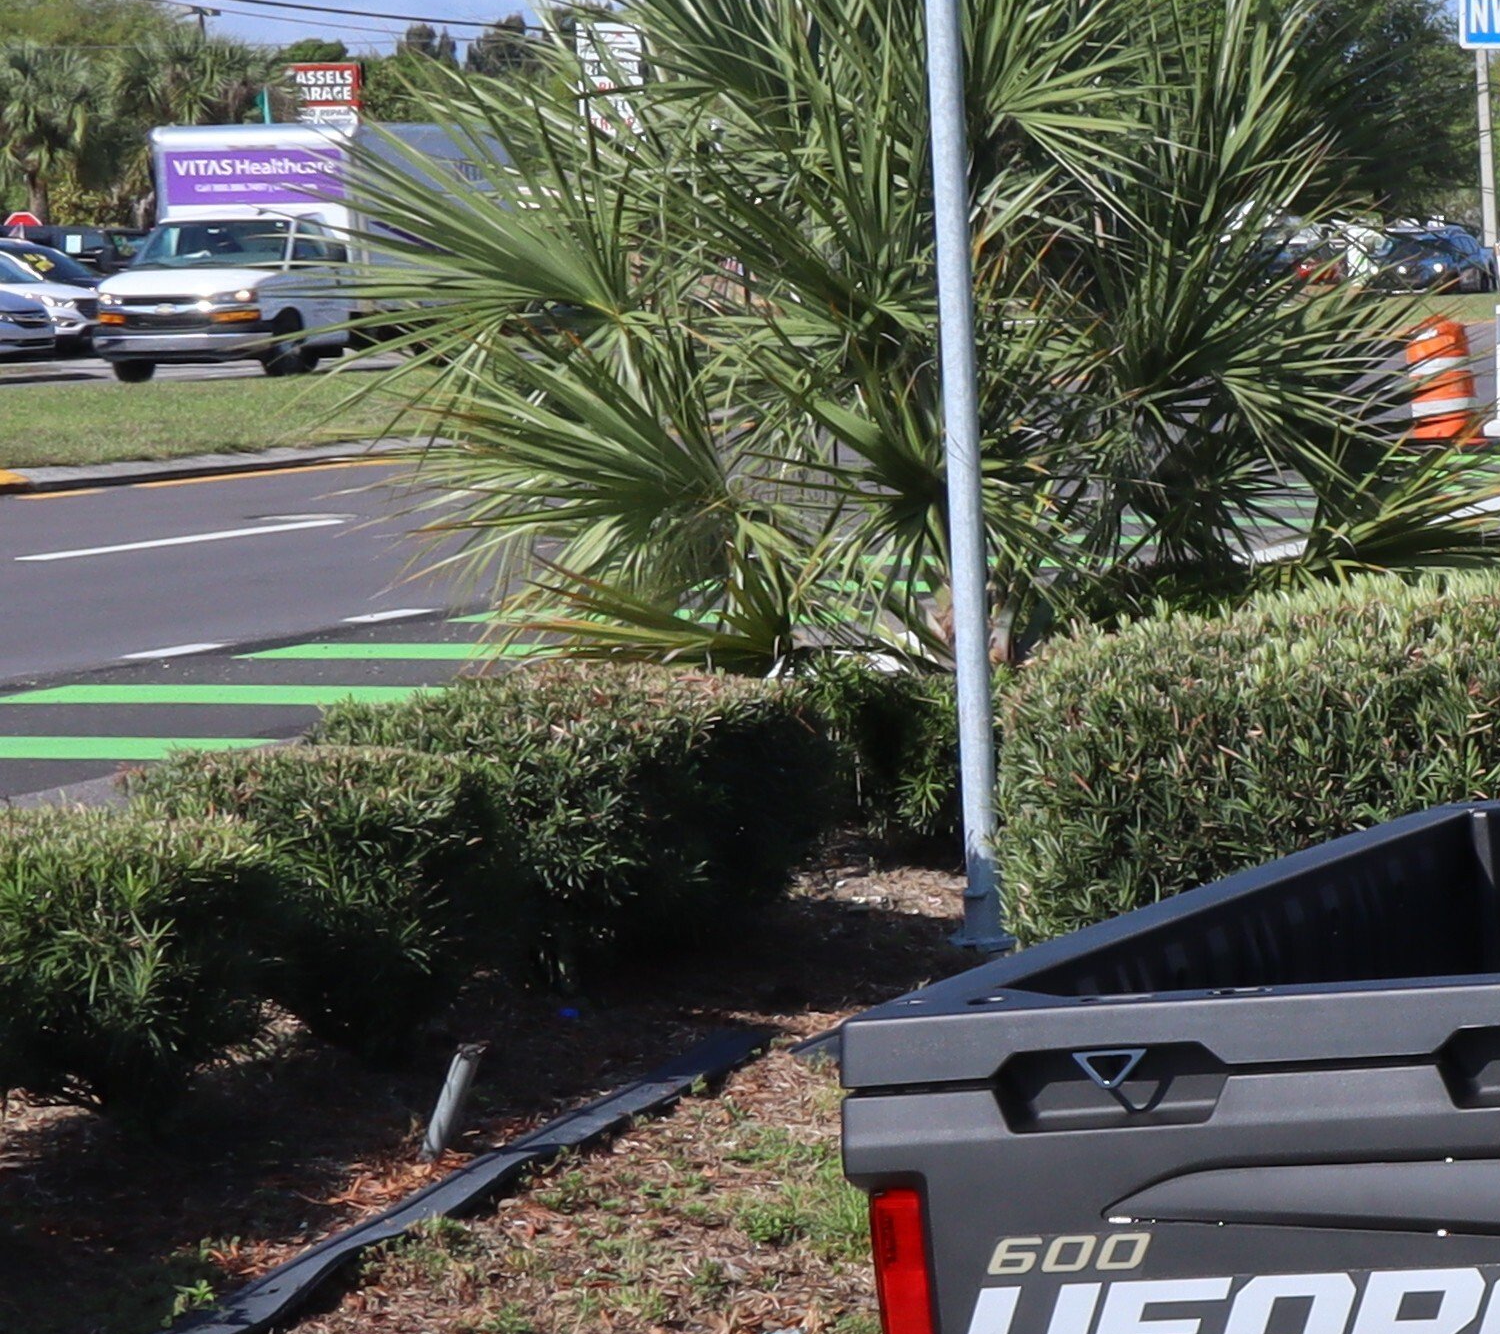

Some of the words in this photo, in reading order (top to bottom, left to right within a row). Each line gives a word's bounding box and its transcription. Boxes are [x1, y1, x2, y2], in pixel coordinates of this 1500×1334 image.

[293, 69, 354, 85] ASSELS
[301, 86, 353, 101] ARAGE
[172, 159, 233, 177] VITAS
[235, 158, 336, 175] Healthcare
[984, 1232, 1151, 1276] 600
